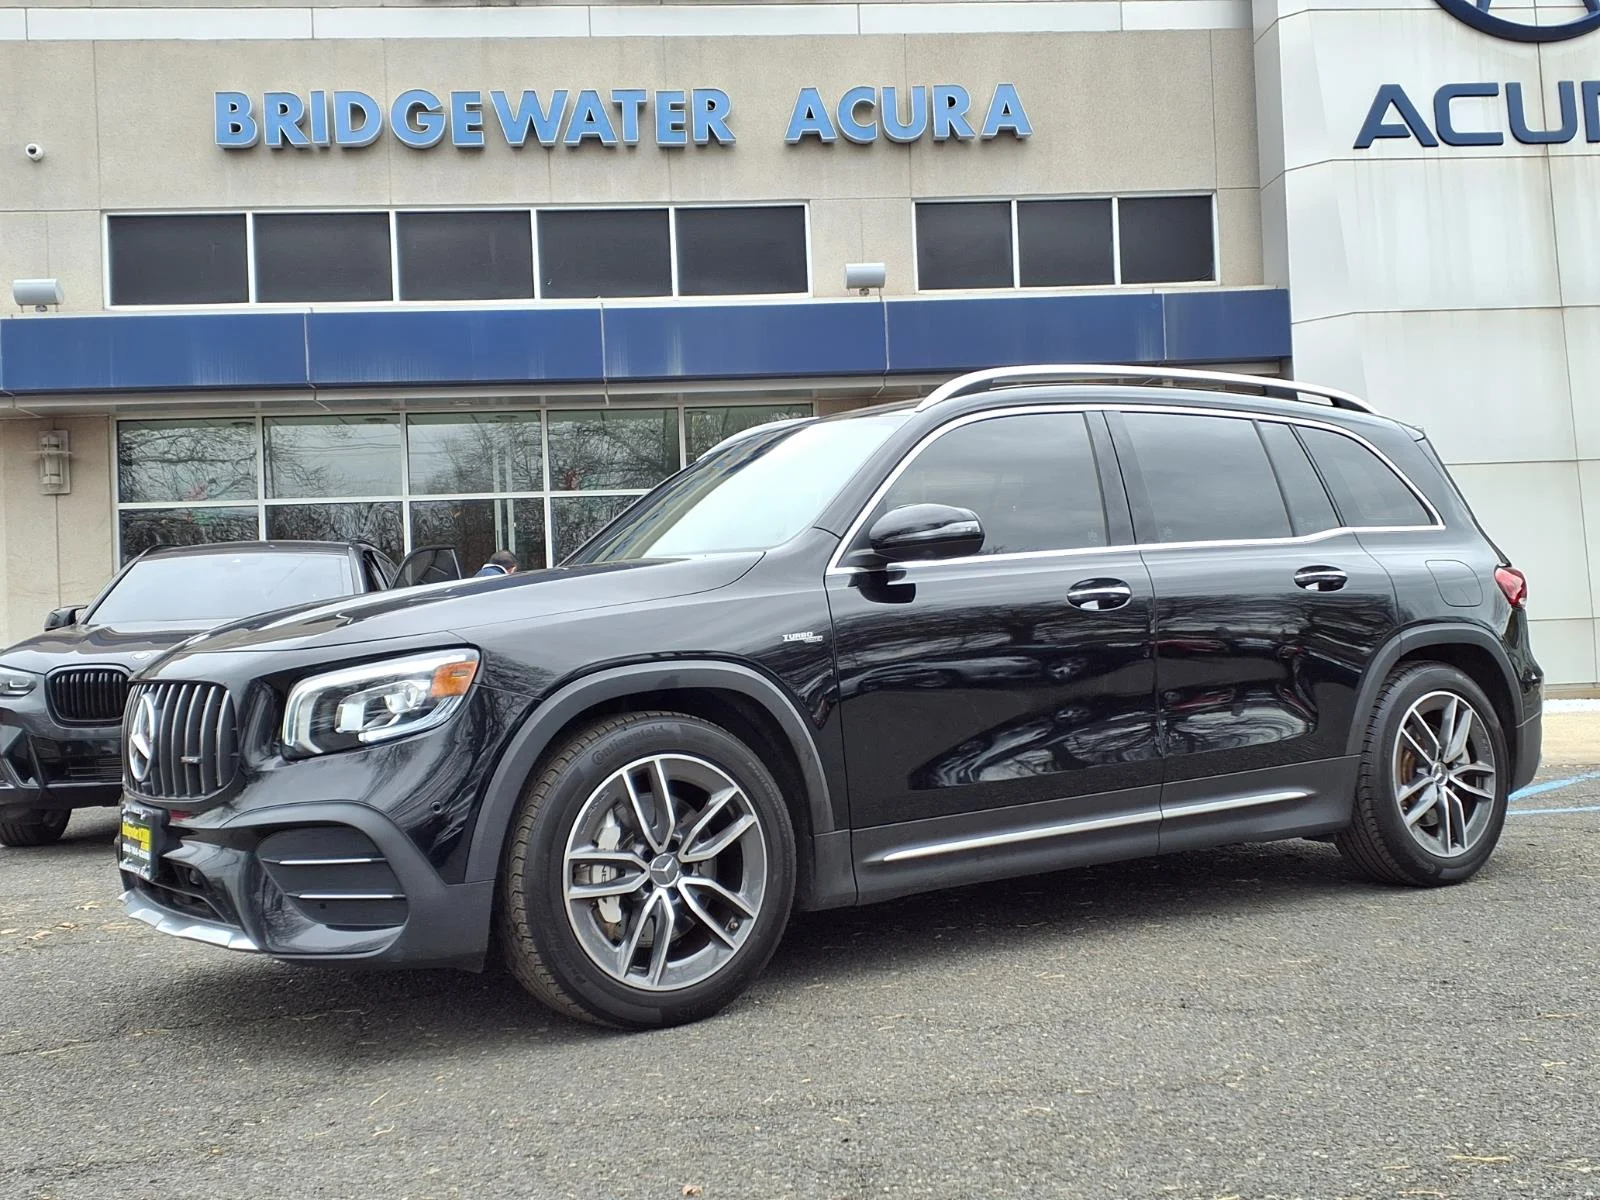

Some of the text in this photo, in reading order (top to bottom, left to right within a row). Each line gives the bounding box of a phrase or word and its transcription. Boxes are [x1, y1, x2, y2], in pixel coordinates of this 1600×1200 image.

[214, 83, 1034, 150] BRIDGEWATER ACURA
[1353, 80, 1600, 149] ACU
[782, 631, 813, 642] TURBO
